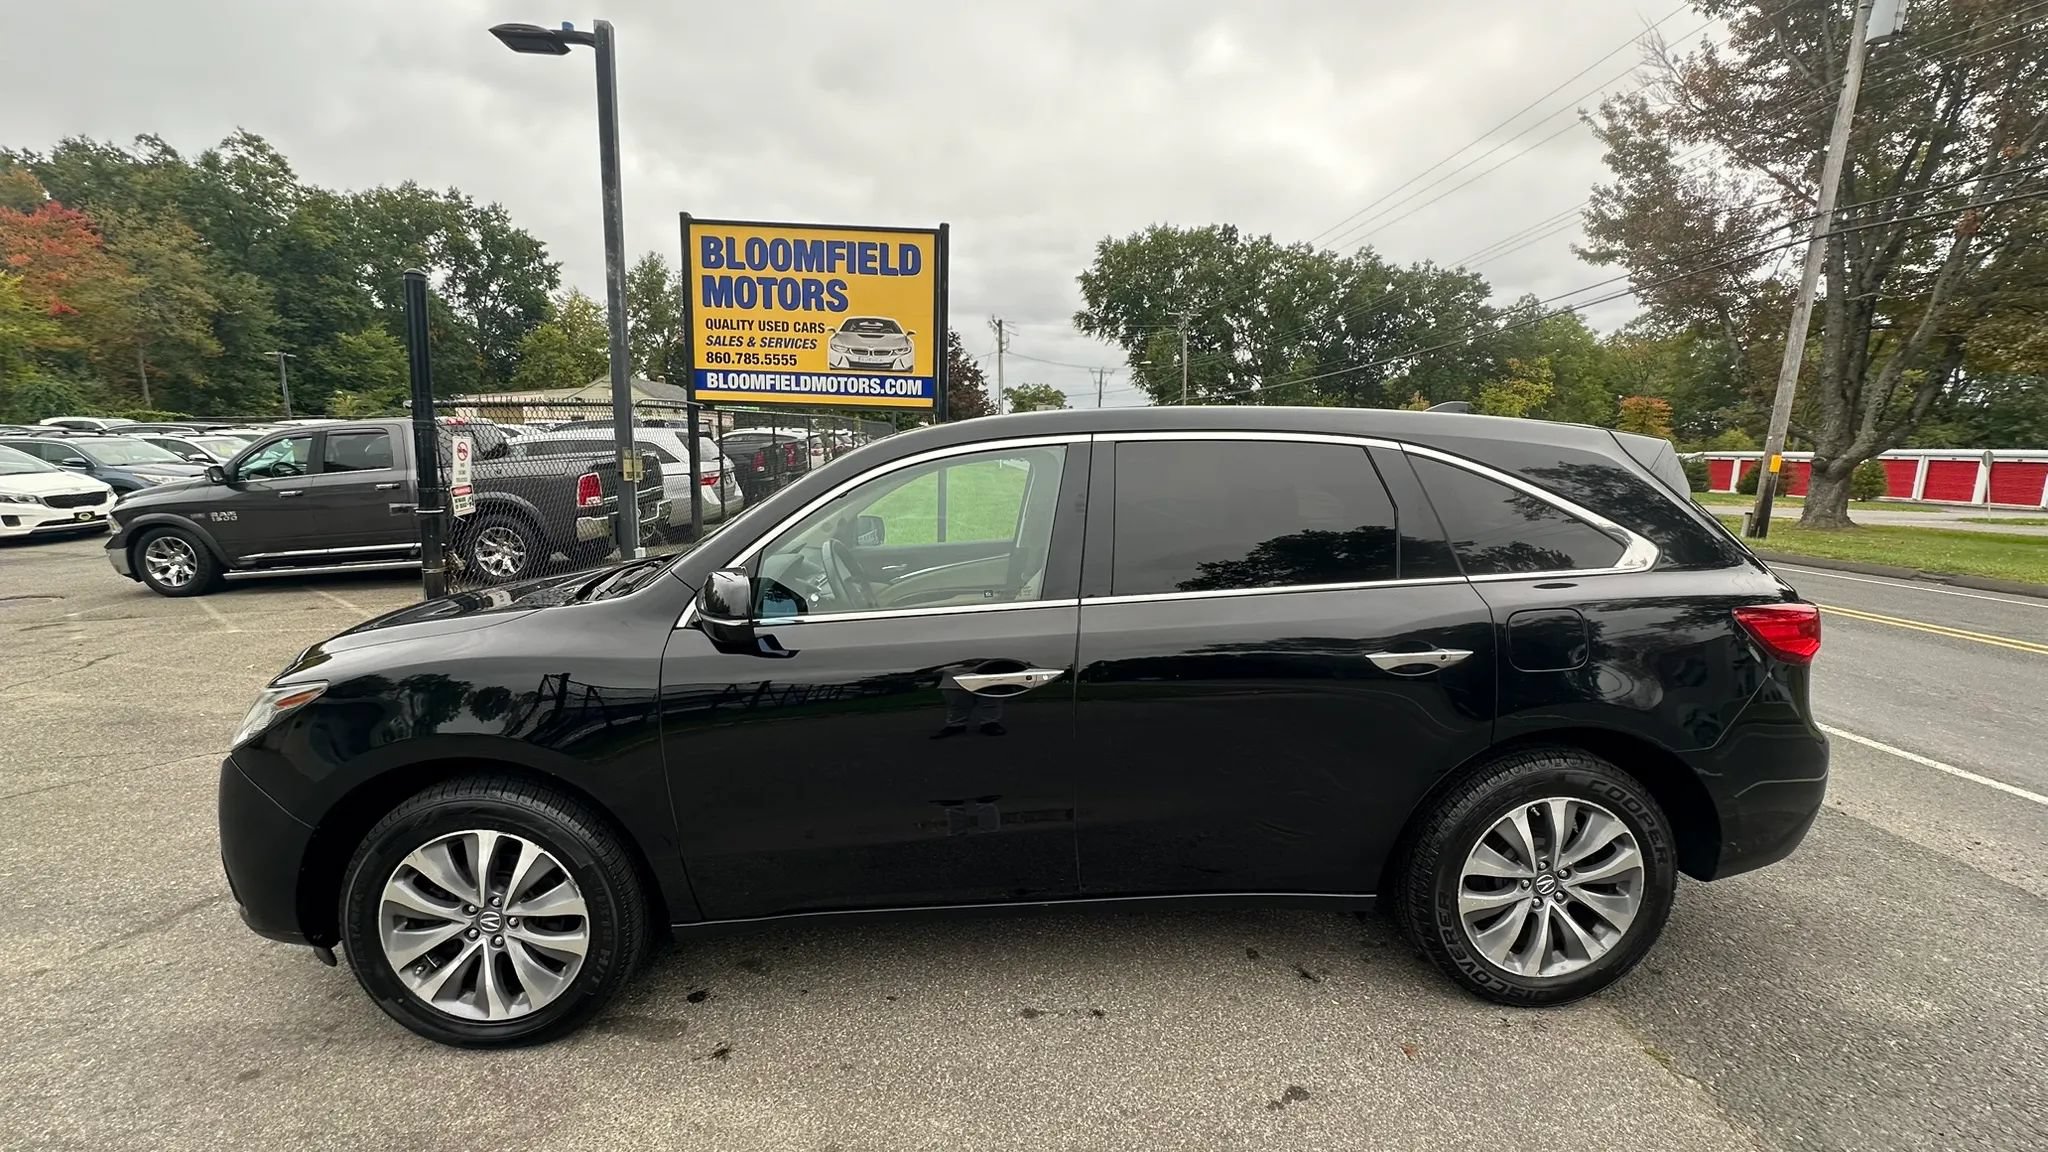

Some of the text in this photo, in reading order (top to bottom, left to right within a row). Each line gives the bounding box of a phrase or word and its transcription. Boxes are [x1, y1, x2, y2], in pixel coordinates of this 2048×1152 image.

[700, 235, 922, 276] BLOOMFIELD
[701, 275, 849, 312] MOTORS
[705, 318, 825, 333] QUALITY USED CARS
[705, 335, 817, 349] SALES & SERVICES
[706, 352, 797, 366] 860.785.5555
[706, 373, 922, 395] BLOOMFIELDMOTORS.COM
[1587, 780, 1671, 865] COOPER
